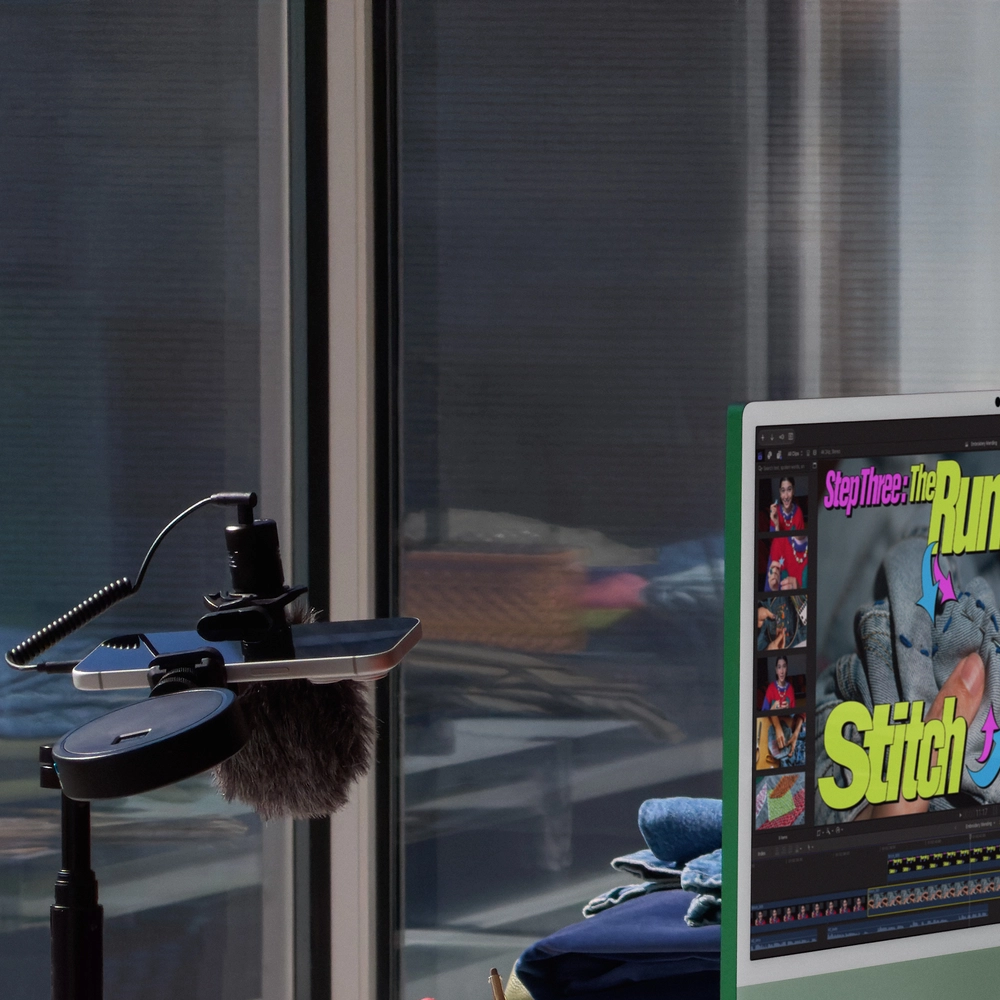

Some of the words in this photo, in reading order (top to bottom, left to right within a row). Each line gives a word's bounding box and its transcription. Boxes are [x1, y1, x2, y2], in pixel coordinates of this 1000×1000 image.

[824, 470, 861, 517] Step
[859, 465, 909, 505] Three:
[909, 463, 937, 503] The
[817, 696, 968, 810] Stitch
